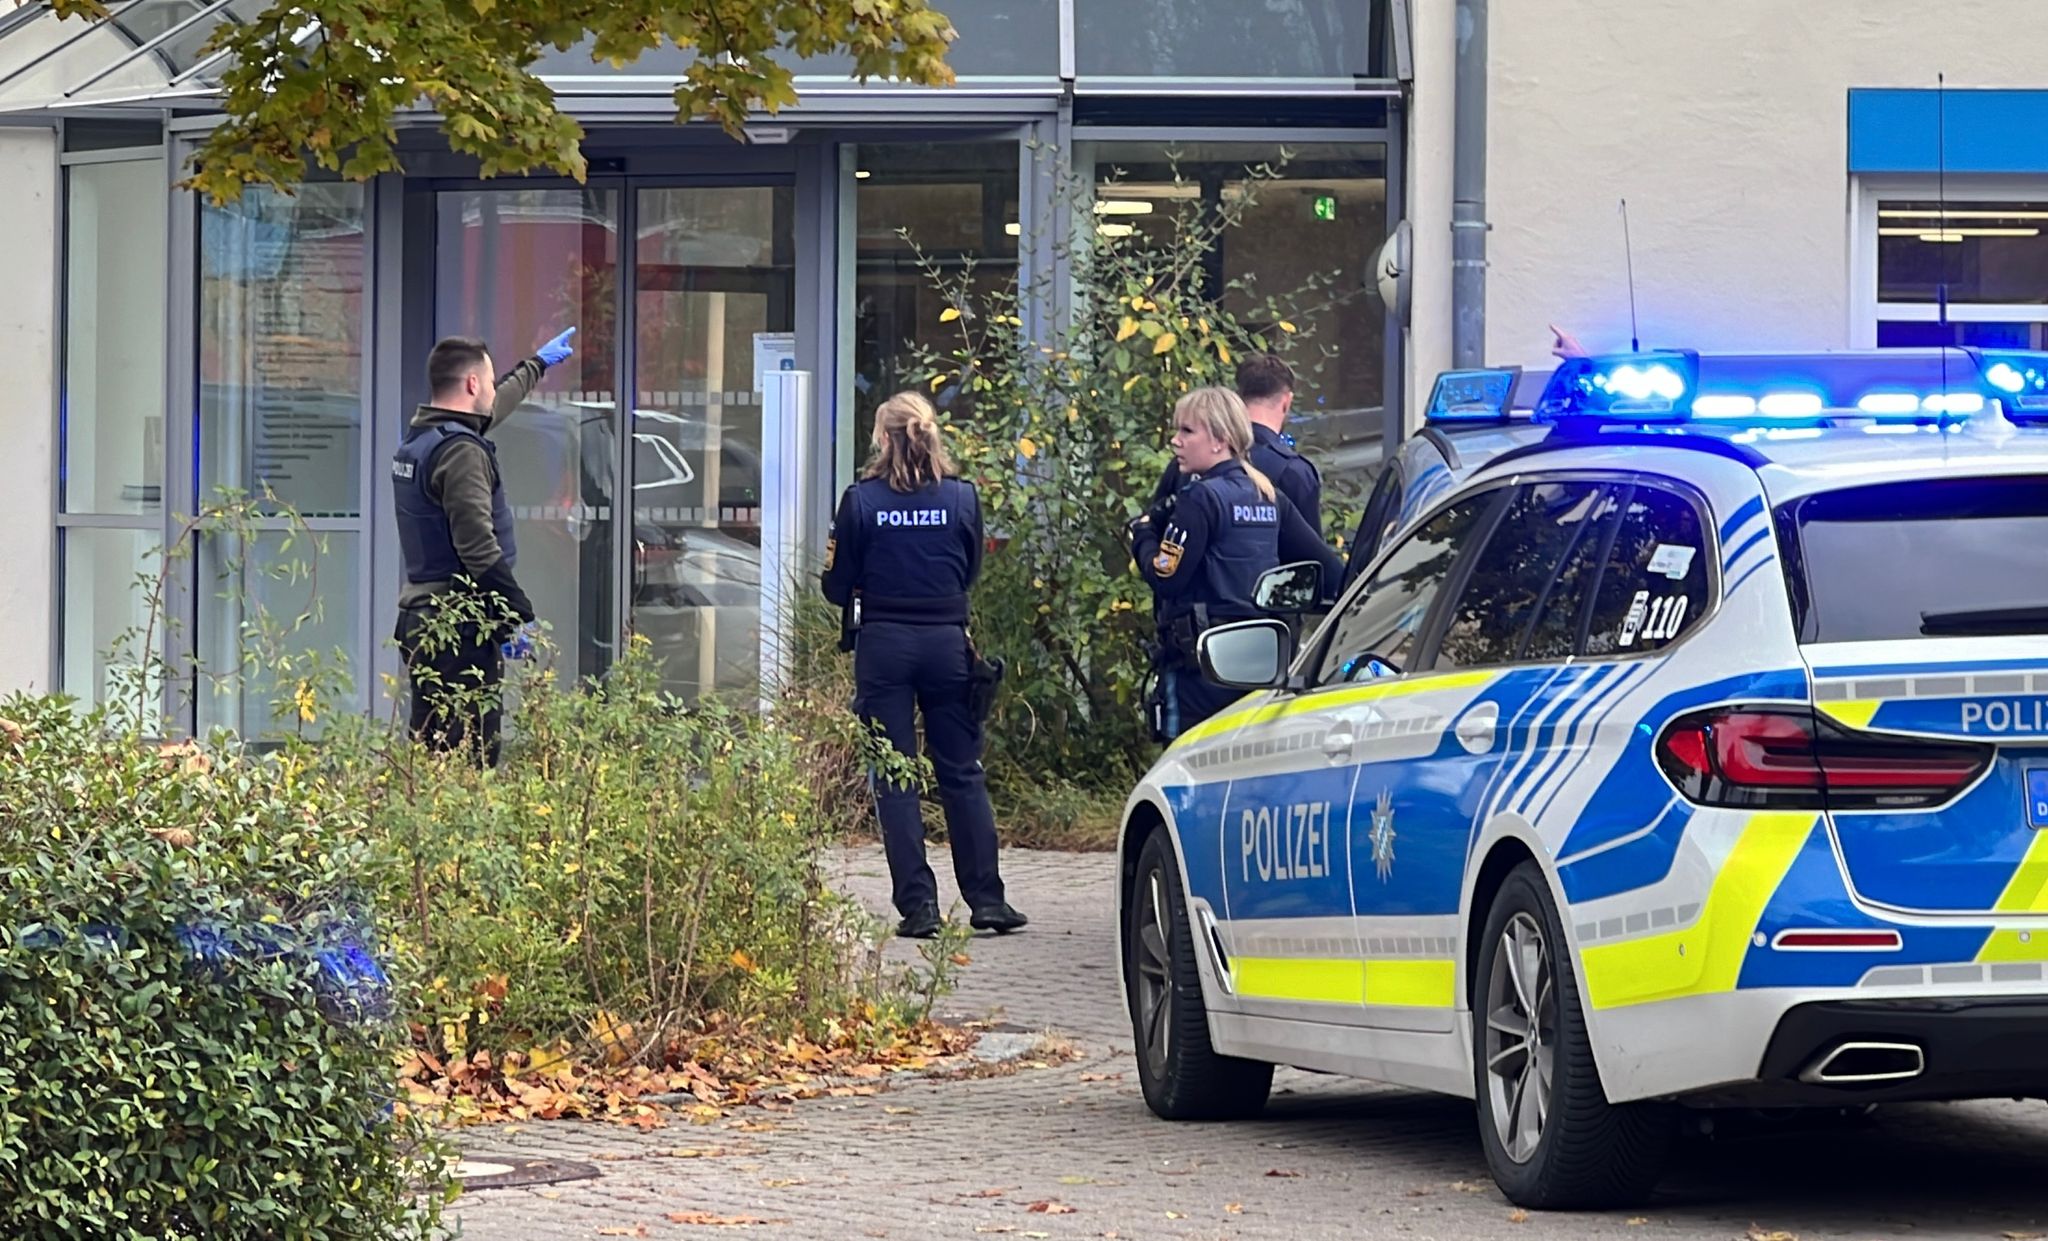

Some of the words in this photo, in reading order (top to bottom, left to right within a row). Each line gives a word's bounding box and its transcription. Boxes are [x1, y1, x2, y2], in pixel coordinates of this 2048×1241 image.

[877, 509, 947, 526] POLIZEI
[1233, 505, 1277, 521] POLIZEI
[1641, 595, 1688, 639] 110
[1961, 701, 2048, 732] POLI
[1241, 801, 1330, 882] POLIZEI
